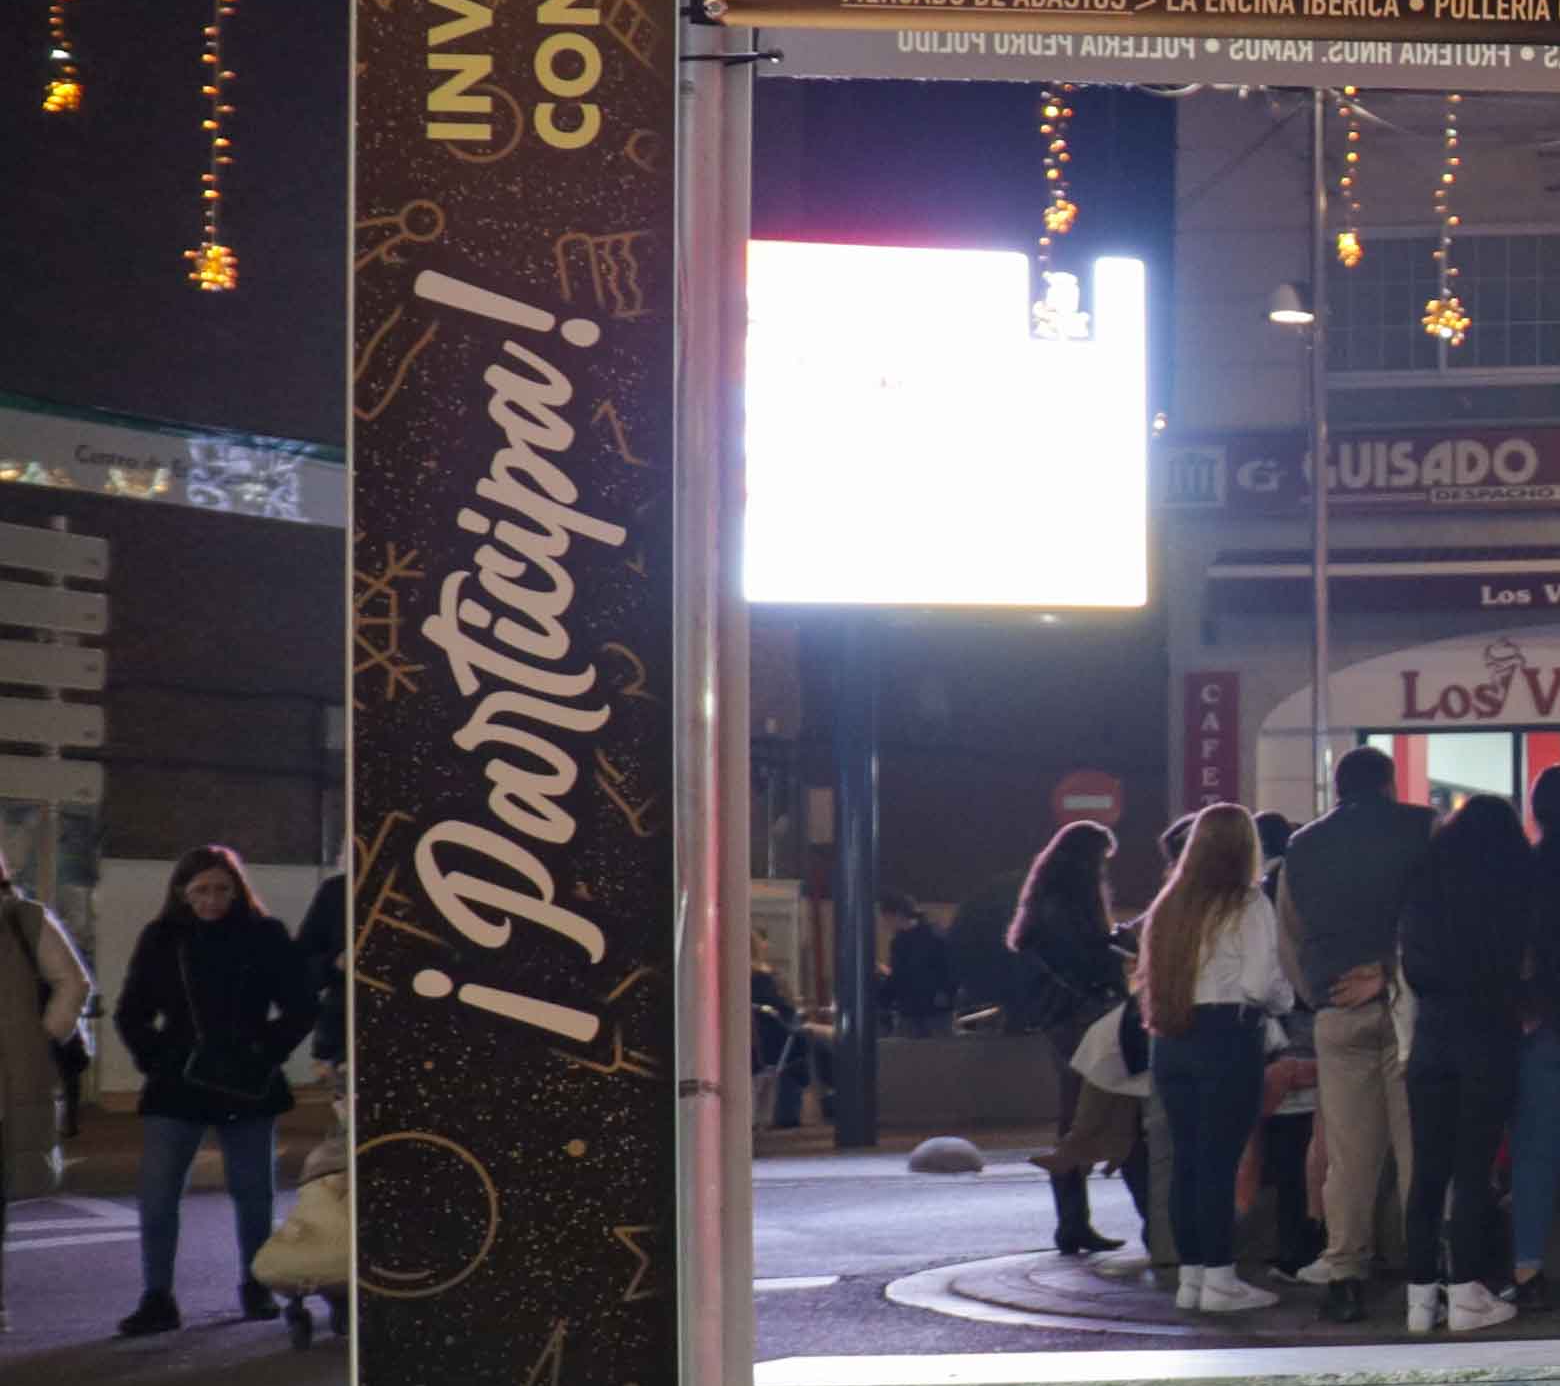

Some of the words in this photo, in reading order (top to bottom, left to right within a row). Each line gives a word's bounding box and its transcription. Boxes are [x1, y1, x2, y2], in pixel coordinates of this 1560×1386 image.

[1435, 486, 1555, 502] DESPACHO
[1481, 585, 1531, 606] Los
[1401, 668, 1501, 722] Los
